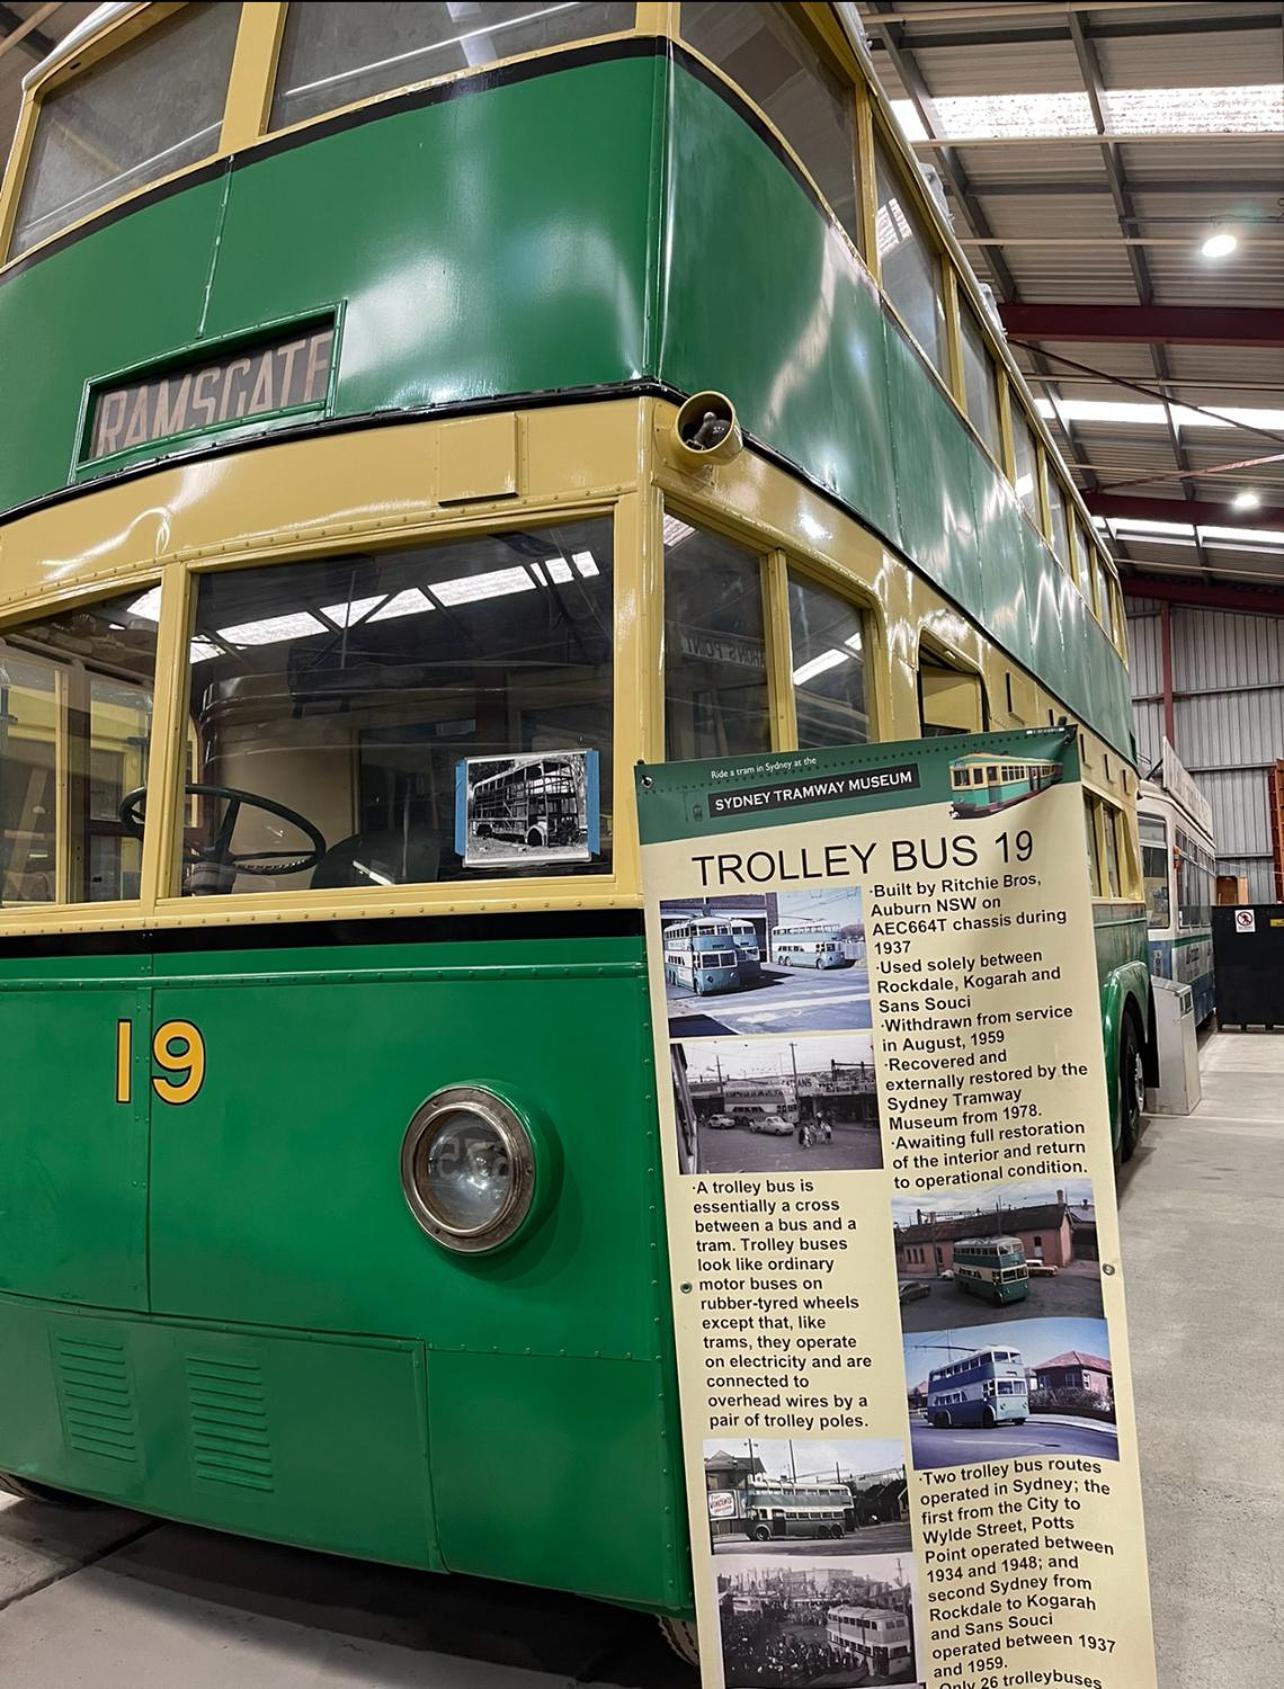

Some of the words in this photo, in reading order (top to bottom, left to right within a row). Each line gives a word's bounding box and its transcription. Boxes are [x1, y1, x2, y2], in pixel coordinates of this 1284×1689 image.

[95, 329, 333, 457] RAMSGATE
[711, 770, 728, 779] Ride
[736, 767, 755, 775] tram
[765, 761, 792, 772] Sydney
[804, 757, 816, 765] the
[715, 792, 770, 810] SYDNEY
[773, 781, 845, 801] TRAMWAY
[849, 771, 912, 791] MUSEUM
[691, 843, 877, 886] TROLLEY
[892, 835, 978, 872] BUS
[995, 830, 1032, 863] 19
[917, 882, 936, 897] by
[942, 876, 999, 892] Ritchie
[1003, 874, 1041, 888] Bros,
[871, 903, 931, 917] Auburn
[937, 897, 977, 912] NSW
[982, 898, 1000, 909] on
[873, 918, 947, 936] AEC664T
[953, 914, 1011, 930] chassis
[1016, 909, 1067, 925] during
[875, 940, 910, 955] 1937
[927, 956, 975, 972] solely
[980, 952, 1042, 967] between
[877, 977, 958, 993] Rockdale,
[964, 970, 1026, 990] Kogarah
[1031, 966, 1061, 981] and
[879, 1000, 919, 1013] Sans
[925, 995, 971, 1010] Souci
[976, 1012, 1011, 1028] from
[1016, 1005, 1073, 1022] service
[883, 1039, 897, 1052] in
[903, 1035, 965, 1053] August,
[971, 1029, 1005, 1046] 1959
[116, 1018, 206, 1106] 19
[980, 1049, 1007, 1064] and
[886, 1074, 964, 1091] externally
[970, 1066, 1032, 1085] restored
[1037, 1065, 1057, 1080] by
[1061, 1062, 1087, 1076] the
[887, 1096, 948, 1114] Sydney
[952, 1089, 1022, 1106] Tramway
[889, 1117, 958, 1130] Museum
[962, 1111, 998, 1125] from
[1003, 1104, 1042, 1120] 1978.
[970, 1128, 994, 1143] full
[999, 1121, 1085, 1140] restoration
[893, 1156, 908, 1169] of
[913, 1155, 939, 1168] the
[944, 1149, 999, 1166] interior
[1004, 1143, 1031, 1159] and
[1036, 1141, 1085, 1155] return
[894, 1177, 910, 1189] to
[915, 1166, 1003, 1190] operational
[1008, 1160, 1087, 1177] condition.
[713, 1180, 761, 1196] trolley
[766, 1180, 795, 1193] bus
[800, 1179, 814, 1192] is
[694, 1199, 776, 1215] essentially
[782, 1202, 790, 1212] a
[795, 1201, 839, 1211] cross
[695, 1220, 759, 1233] between
[765, 1221, 773, 1231] a
[778, 1218, 807, 1231] bus
[813, 1217, 842, 1231] and
[848, 1220, 856, 1230] a
[696, 1240, 735, 1252] tram.
[740, 1238, 794, 1254] Trolley
[799, 1237, 847, 1250] buses
[698, 1258, 731, 1271] look
[736, 1257, 763, 1270] like
[768, 1257, 834, 1273] ordinary
[699, 1278, 745, 1291] motor
[750, 1277, 797, 1290] buses
[803, 1280, 822, 1290] on
[701, 1296, 798, 1313] rubber-tyred
[803, 1295, 859, 1309] wheels
[702, 1317, 754, 1332] except
[758, 1316, 793, 1331] that,
[798, 1316, 826, 1329] like
[703, 1336, 752, 1350] trams,
[757, 1335, 791, 1352] they
[796, 1336, 856, 1351] operate
[705, 1358, 724, 1368] on
[730, 1354, 806, 1371] electricity
[812, 1354, 841, 1368] and
[847, 1357, 871, 1367] are
[707, 1374, 788, 1387] connected
[793, 1376, 809, 1388] to
[708, 1393, 781, 1407] overhead
[786, 1394, 828, 1408] wires
[834, 1394, 853, 1411] by
[859, 1397, 867, 1407] a
[710, 1413, 739, 1430] pair
[744, 1413, 760, 1426] of
[764, 1414, 814, 1431] trolley
[820, 1414, 868, 1430] poles.
[961, 1464, 1009, 1481] trolley
[1014, 1460, 1043, 1473] bus
[1048, 1459, 1101, 1473] routes
[920, 1484, 989, 1508] operated
[994, 1482, 1008, 1496] in
[1013, 1477, 1078, 1495] Sydney;
[1084, 1479, 1110, 1495] the
[921, 1510, 954, 1525] first
[957, 1506, 993, 1521] from
[998, 1501, 1022, 1515] the
[1027, 1496, 1059, 1513] City
[1064, 1497, 1080, 1510] to
[923, 1527, 971, 1546] Wylde
[977, 1519, 1026, 1537] Street,
[1032, 1516, 1074, 1530] Potts
[925, 1547, 967, 1564] Point
[971, 1536, 1039, 1560] operated
[1045, 1535, 1114, 1555] between
[927, 1566, 963, 1583] 1934
[968, 1561, 996, 1578] and
[1002, 1556, 1042, 1572] 1948;
[1048, 1556, 1078, 1569] and
[928, 1582, 985, 1603] second
[990, 1577, 1048, 1595] Sydney
[1053, 1574, 1092, 1590] from
[930, 1600, 1002, 1622] Rockdale
[1006, 1598, 1022, 1610] to
[1027, 1594, 1096, 1610] Kogarah
[931, 1625, 960, 1640] and
[965, 1621, 1003, 1636] Sans
[1008, 1612, 1052, 1629] Souci
[932, 1637, 1001, 1661] operated
[1006, 1634, 1072, 1649] between
[1079, 1634, 1116, 1653] 1937
[934, 1662, 962, 1678] and
[968, 1656, 1007, 1673] 1959.
[981, 1676, 998, 1689] 26
[1003, 1669, 1102, 1689] trolleybuses
